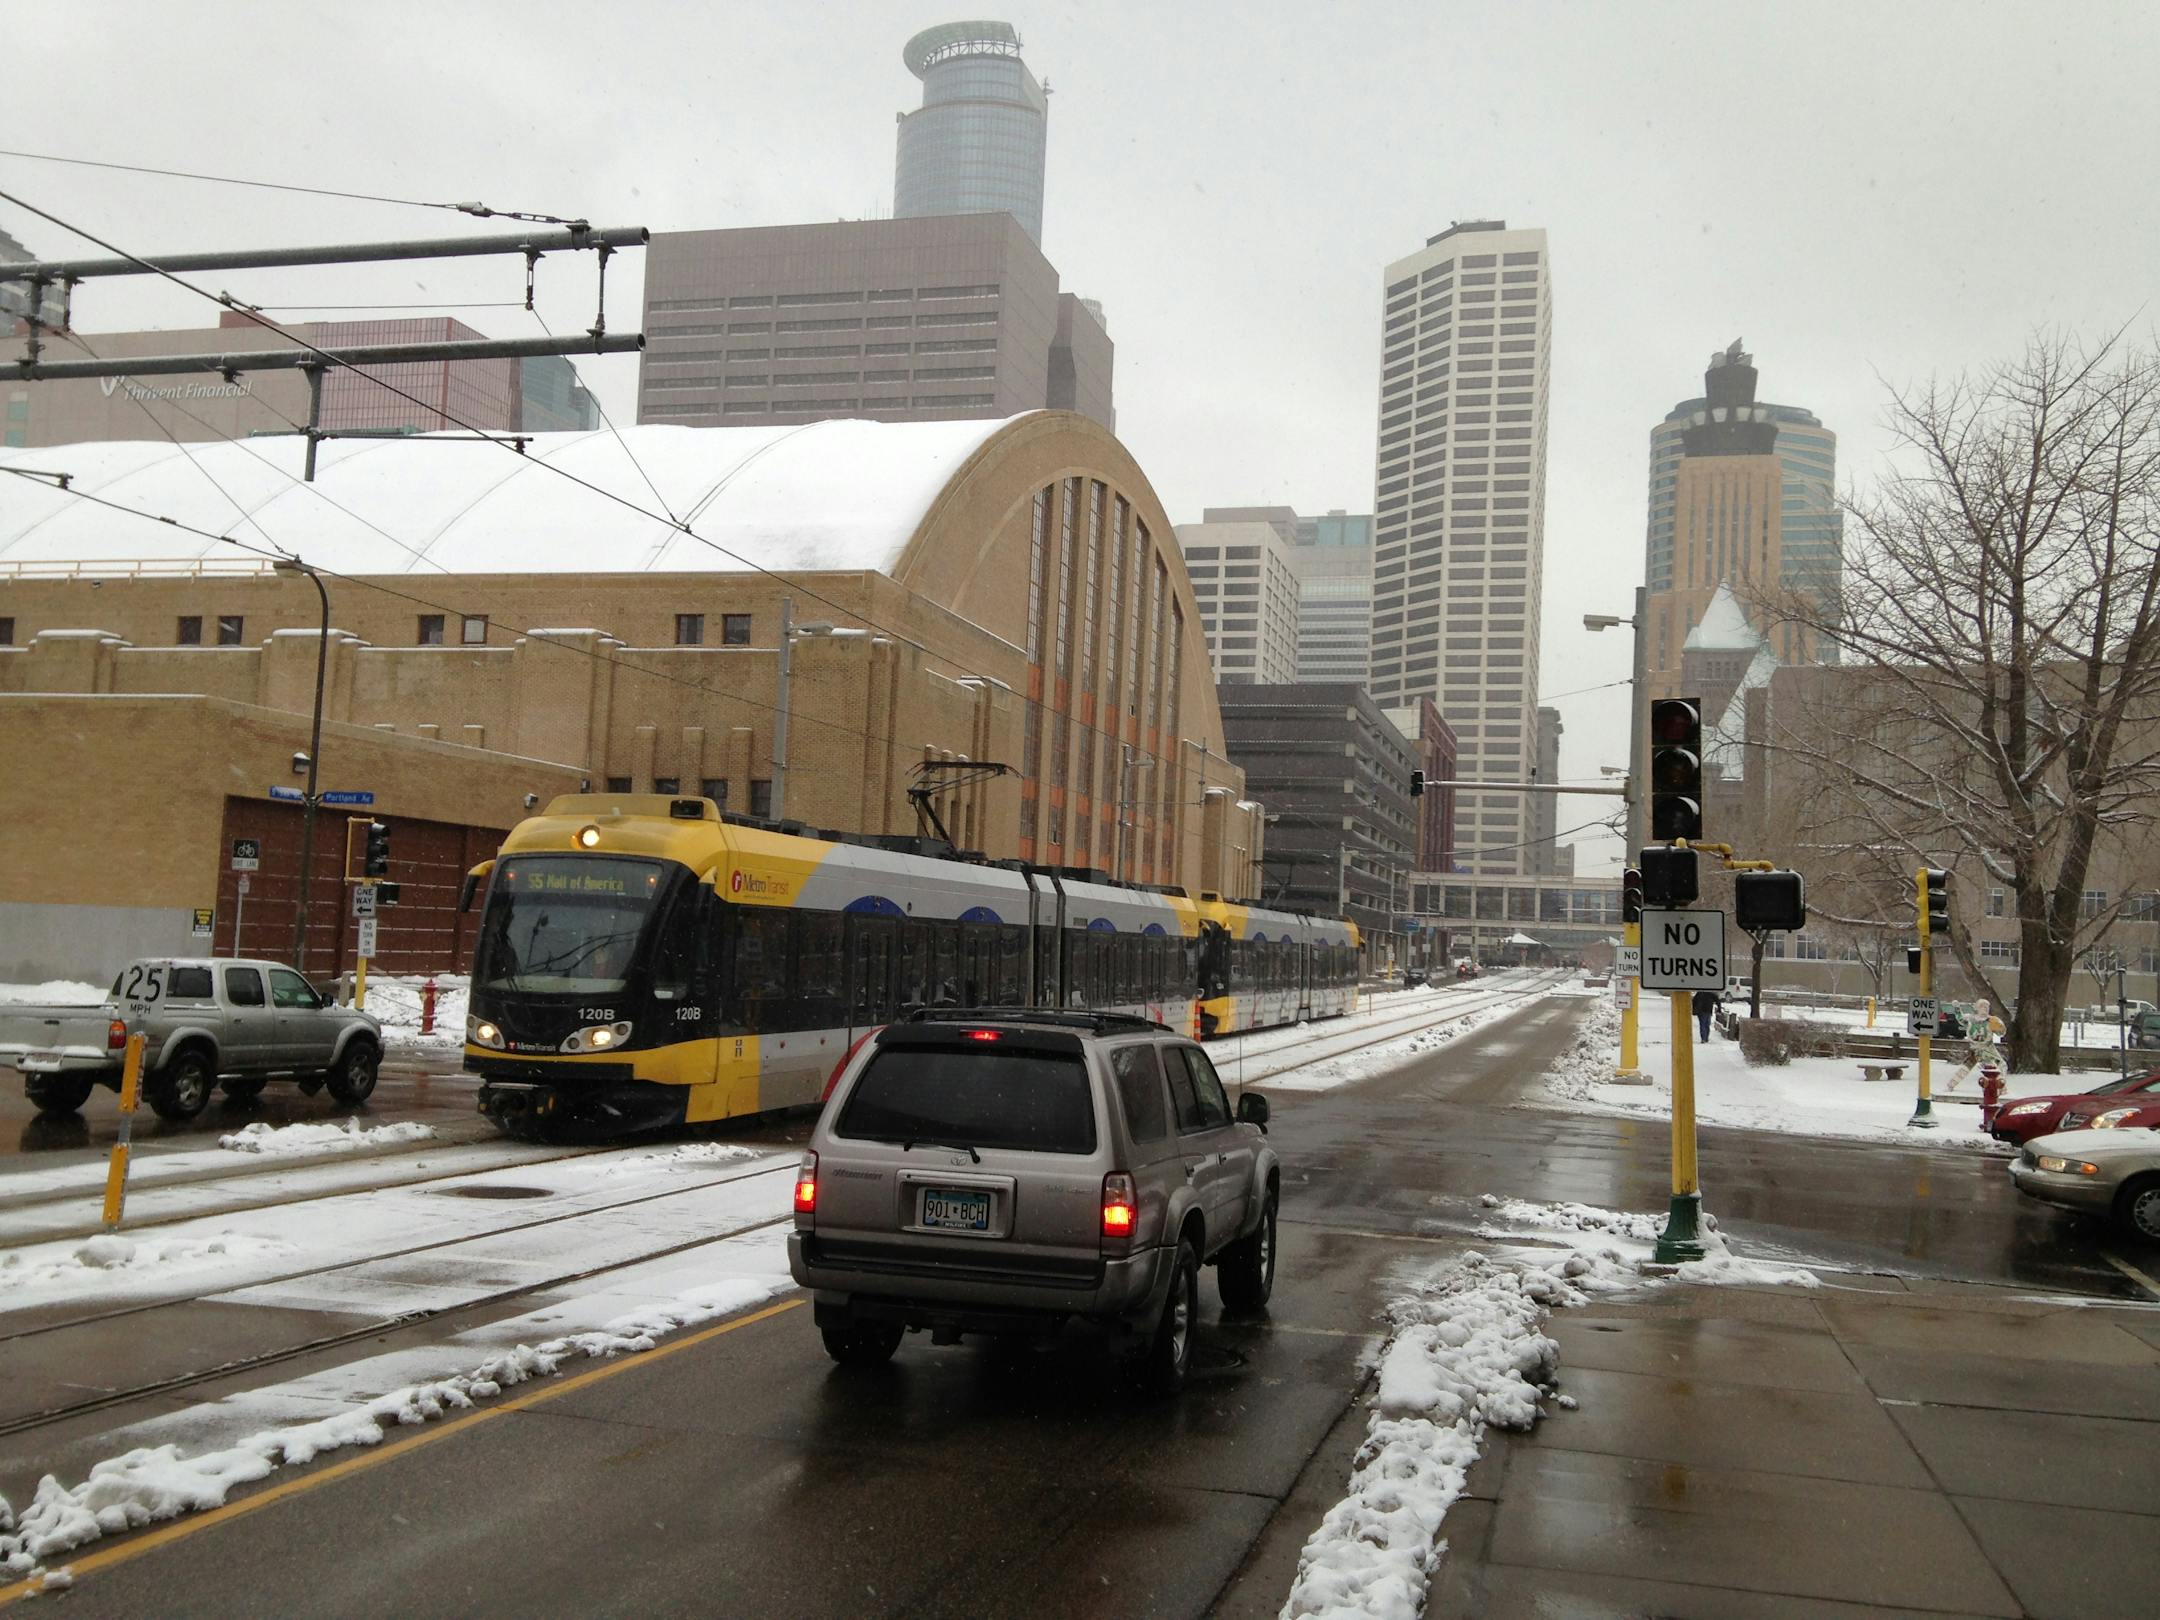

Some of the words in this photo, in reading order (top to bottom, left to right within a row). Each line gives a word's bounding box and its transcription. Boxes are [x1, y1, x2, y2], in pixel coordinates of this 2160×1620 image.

[125, 384, 183, 400] Thrivent
[185, 381, 253, 399] Financial
[547, 873, 567, 889] Mall
[570, 876, 582, 890] of
[584, 875, 625, 891] America
[356, 887, 374, 896] ONE
[355, 897, 373, 905] WAY
[363, 922, 373, 931] NO
[1664, 923, 1700, 945] NO
[1624, 951, 1639, 961] NO
[1618, 963, 1640, 972] TURN
[1648, 957, 1718, 977] TURNS
[126, 965, 163, 1002] 25
[129, 1003, 152, 1015] MPH
[1912, 999, 1936, 1009] ONE
[578, 1008, 615, 1020] 120B
[675, 1007, 701, 1020] 120B
[1911, 1010, 1935, 1020] WAY
[927, 1200, 950, 1219] 901
